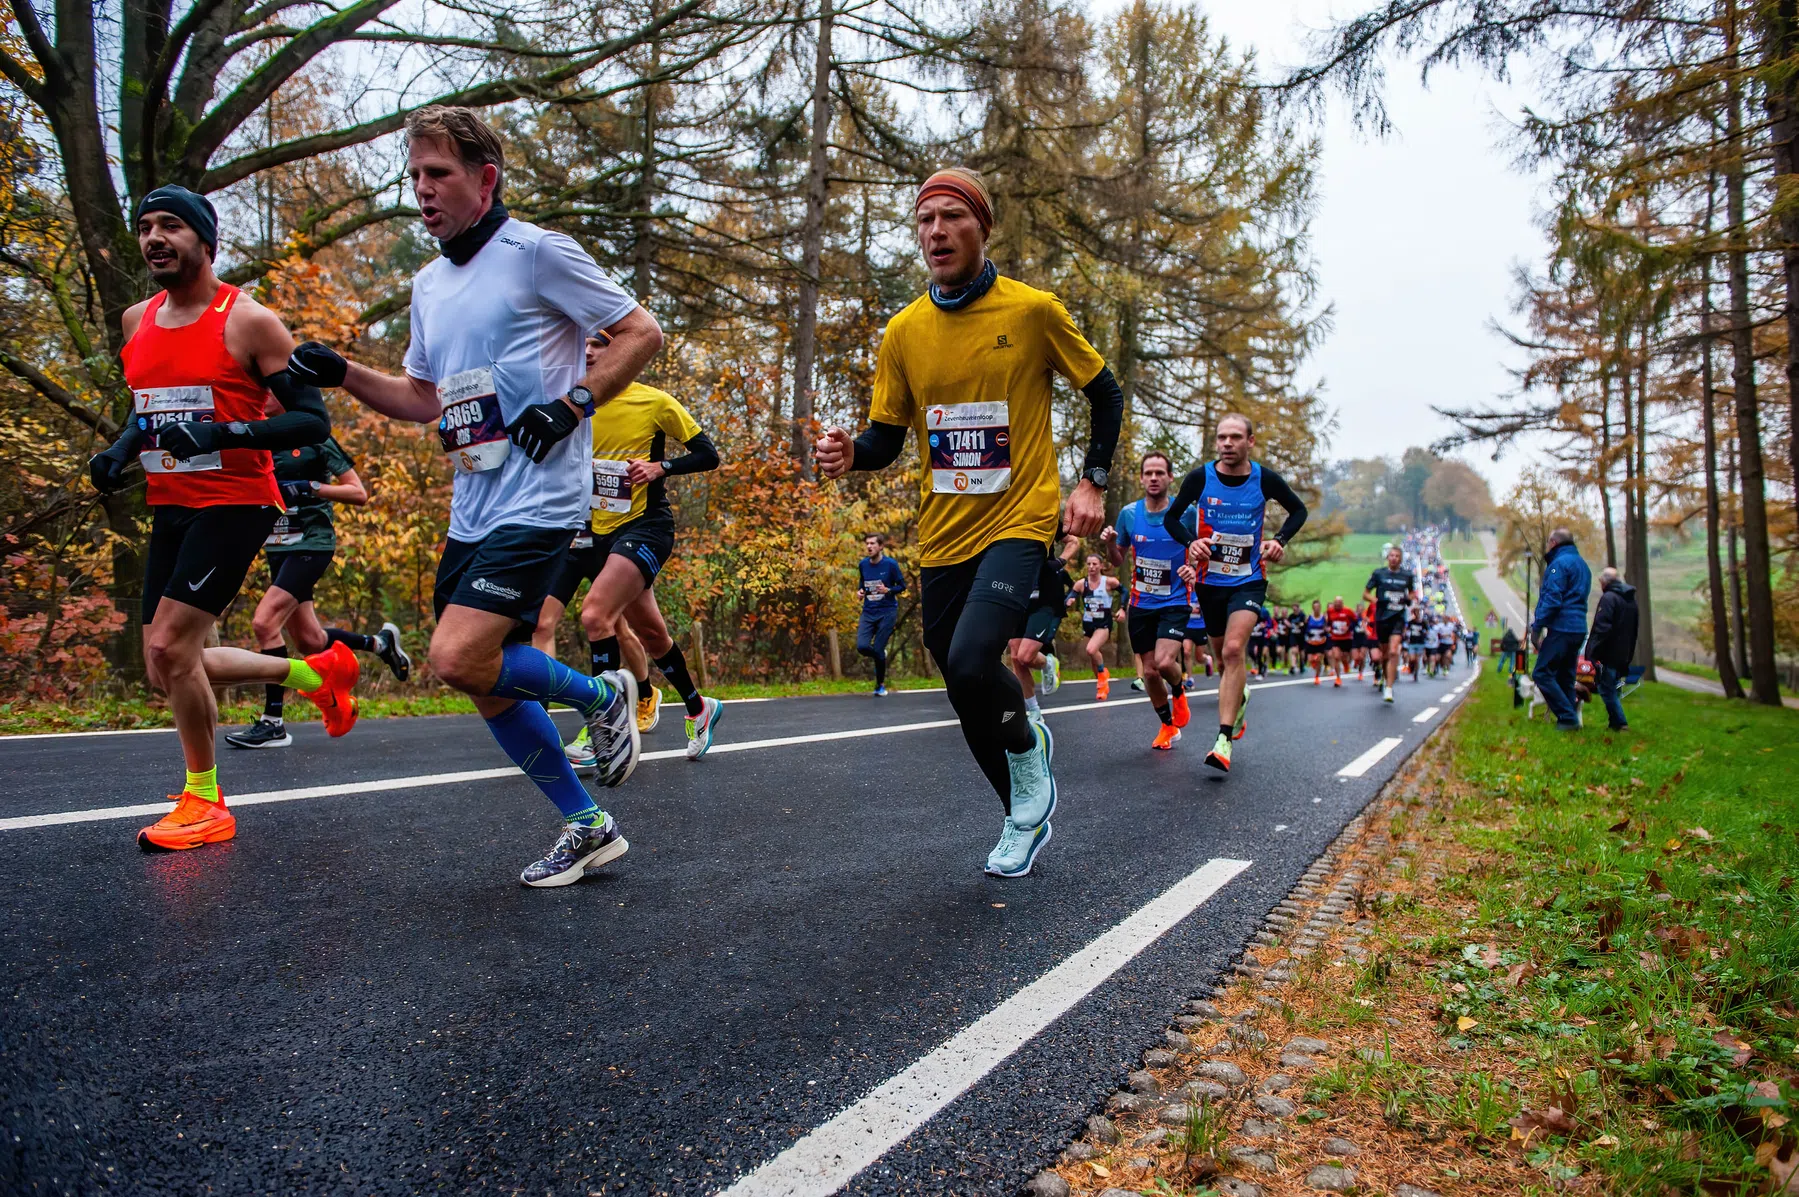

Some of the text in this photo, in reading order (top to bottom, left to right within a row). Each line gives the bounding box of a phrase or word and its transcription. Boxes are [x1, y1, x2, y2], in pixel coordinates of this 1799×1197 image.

[140, 393, 150, 409] 7
[933, 409, 994, 426] 7 Zevenheuvelenloop
[946, 430, 986, 451] 17411
[952, 451, 982, 467] SIMON
[596, 474, 620, 488] 5599
[1221, 545, 1243, 556] 8754
[1142, 568, 1163, 578] 11432
[991, 580, 1014, 593] GORE
